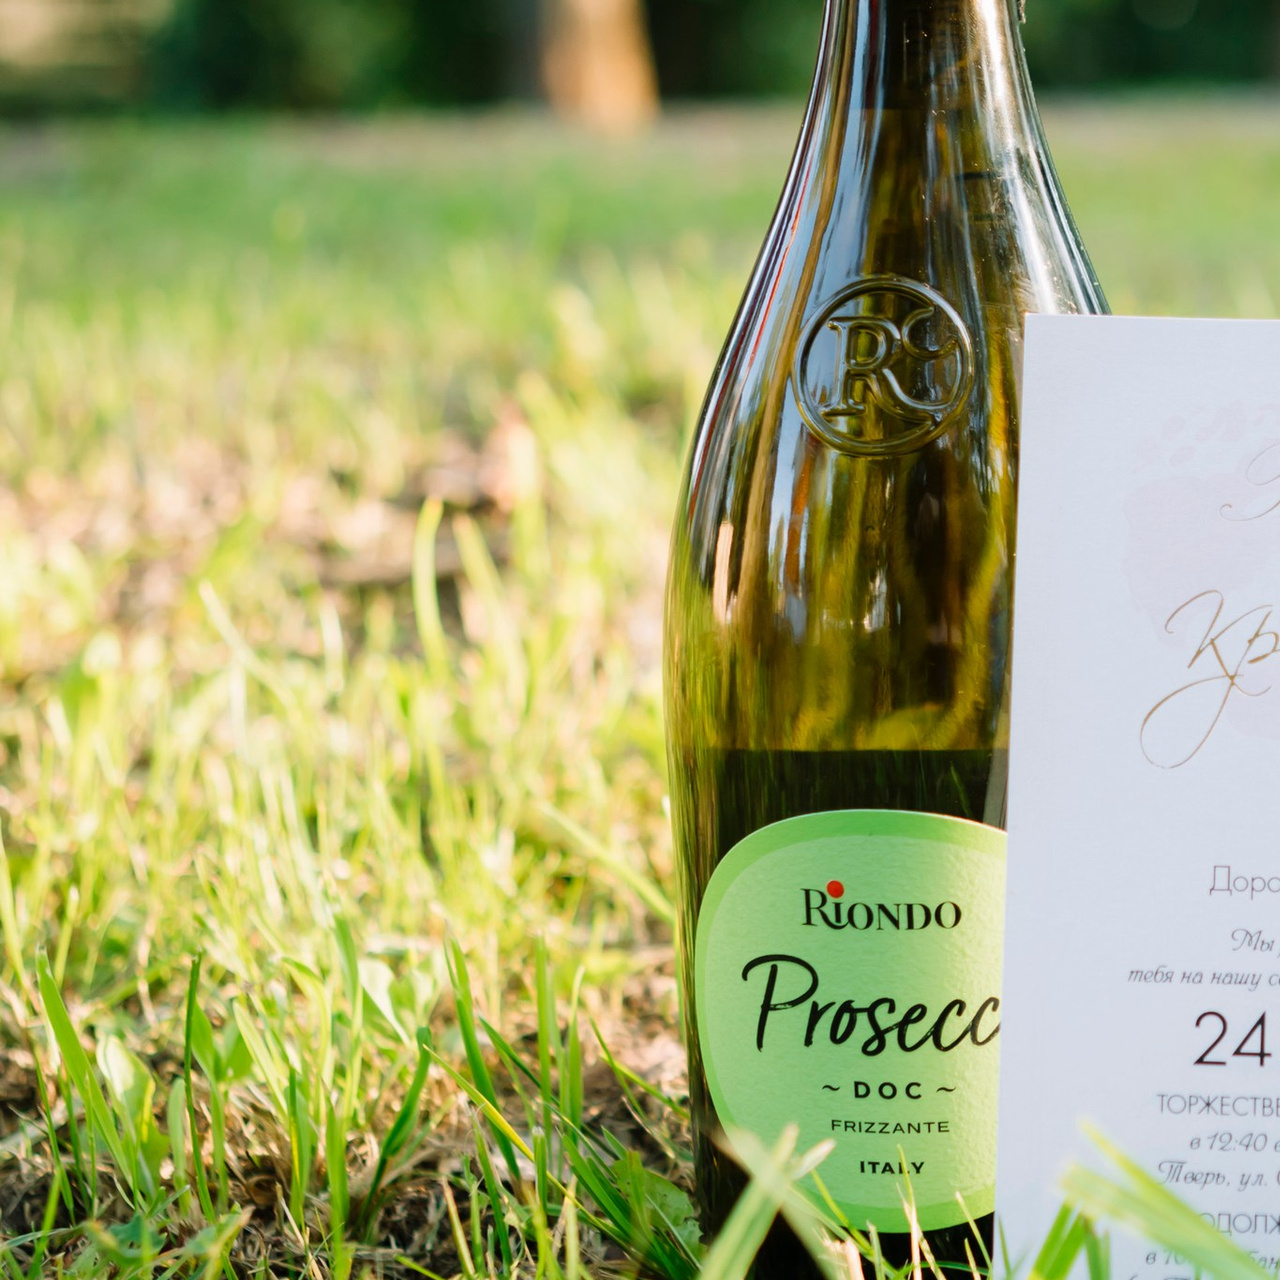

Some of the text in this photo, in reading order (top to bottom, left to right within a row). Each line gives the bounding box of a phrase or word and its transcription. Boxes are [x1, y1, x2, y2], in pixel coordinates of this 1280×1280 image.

[1231, 928, 1274, 952] Мы
[1127, 965, 1174, 984] тебя
[1181, 971, 1204, 985] на
[1210, 971, 1262, 992] нашу
[741, 953, 1002, 1057] Prosecc
[853, 1081, 923, 1099] DOC
[831, 1119, 950, 1134] FRIZZANTE
[1190, 1137, 1201, 1150] в
[1207, 1132, 1268, 1153] 12:40
[860, 1160, 925, 1175] ITALY
[1158, 1160, 1230, 1190] Тверь,
[1237, 1171, 1268, 1192] ул.
[1145, 1252, 1157, 1265] в
